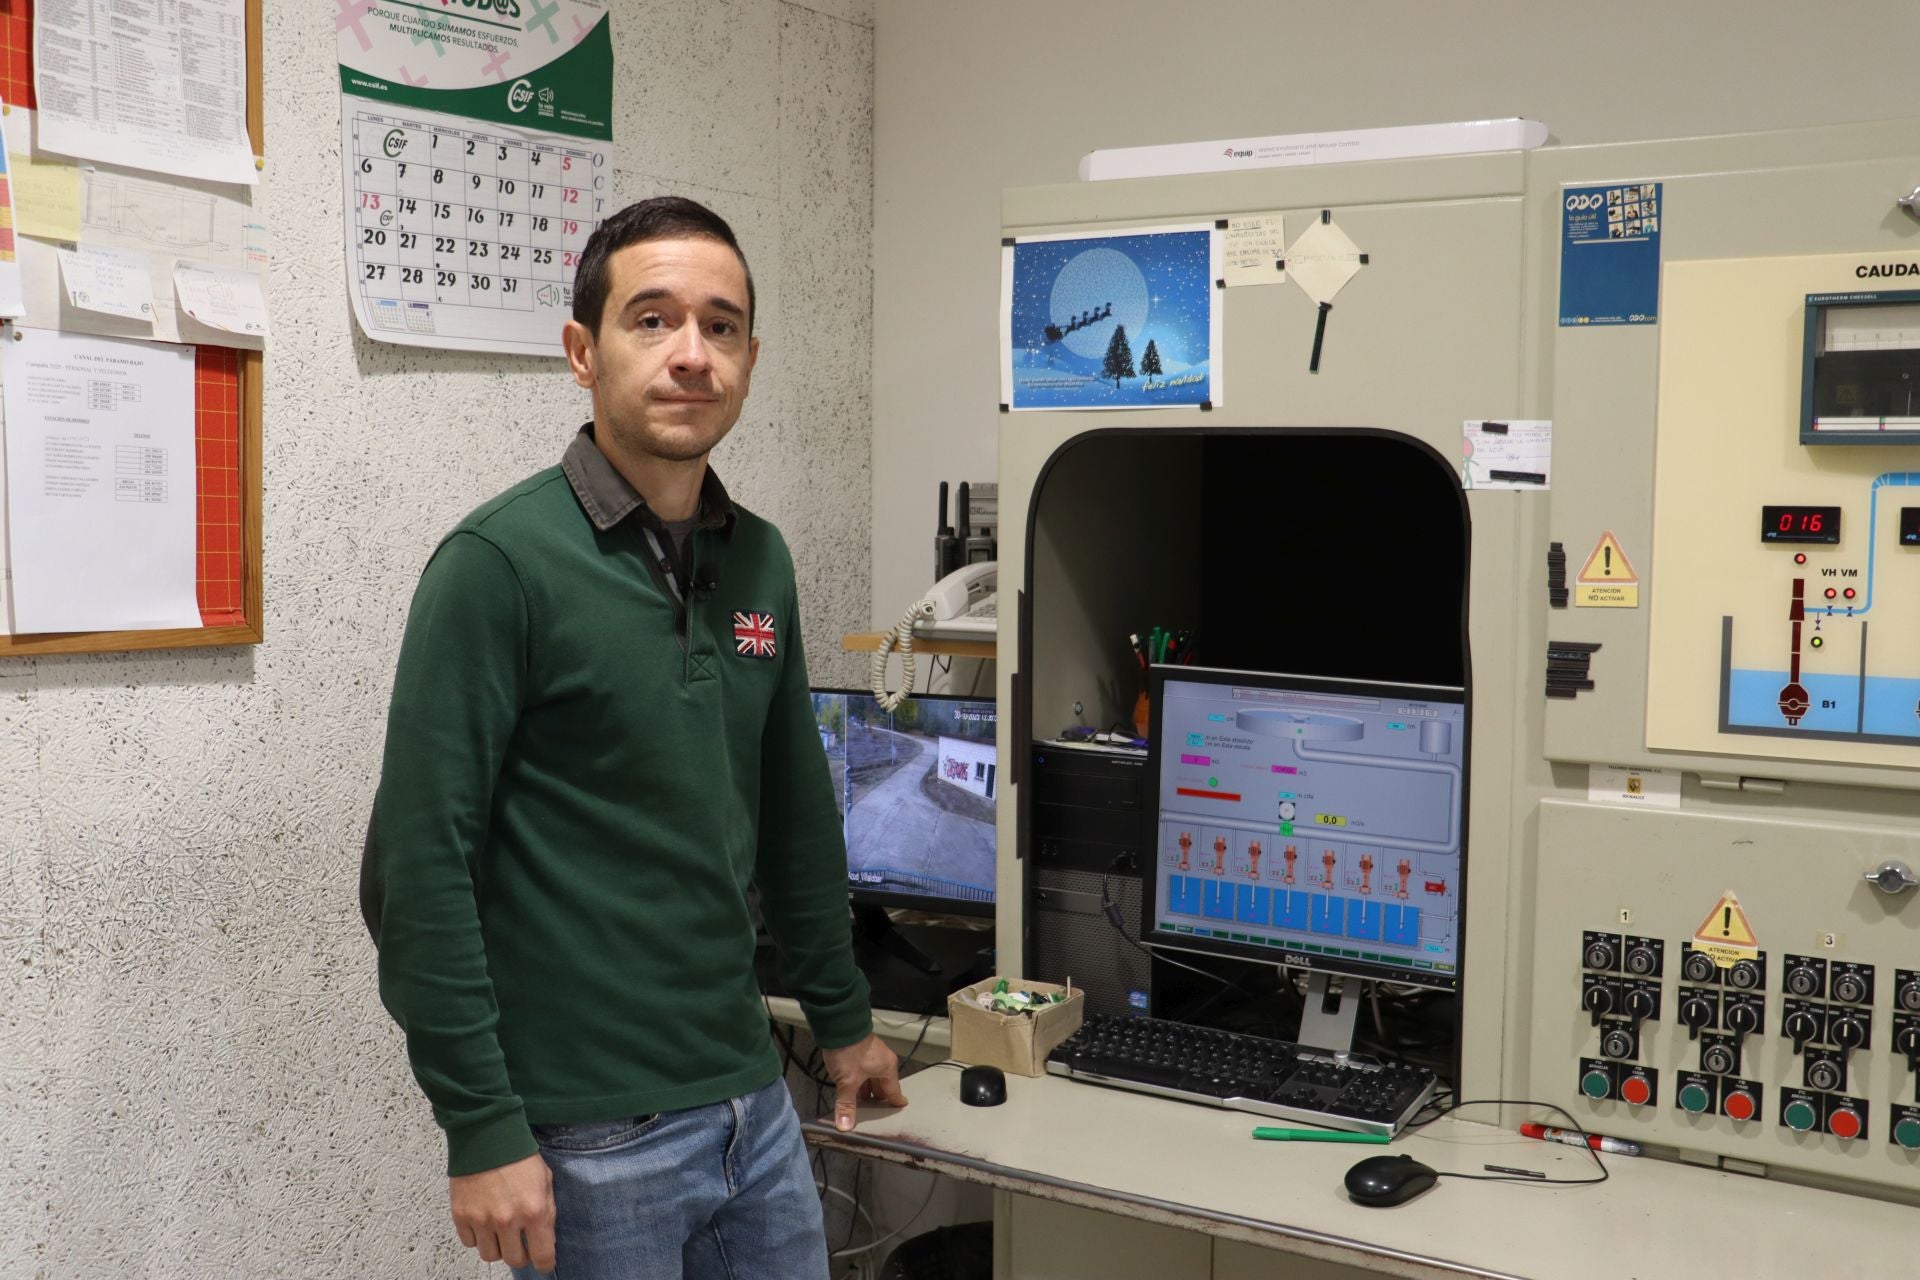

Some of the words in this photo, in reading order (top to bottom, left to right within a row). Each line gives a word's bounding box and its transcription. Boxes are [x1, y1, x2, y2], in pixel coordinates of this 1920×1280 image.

[367, 7, 400, 21] PORQUE
[402, 13, 436, 28] CUANDO
[437, 21, 476, 38] SUMAMOS
[477, 31, 519, 47] ESFUERZOS,
[389, 23, 451, 43] MULTIPLICAMOS
[452, 36, 499, 53] RESULTADOS.
[351, 78, 388, 91] www.csif.es
[402, 121, 422, 129] MARTES
[432, 134, 438, 149] 1
[466, 141, 475, 155] 2
[497, 146, 507, 160] 3
[531, 152, 541, 166] 4
[562, 157, 571, 171] 5
[1233, 149, 1253, 158] equip
[361, 158, 372, 173] 6
[397, 163, 406, 178] 7
[433, 168, 444, 184] 8
[472, 175, 481, 189] 9
[498, 179, 515, 194] 10
[531, 184, 544, 199] 11
[562, 188, 578, 204] 12
[1566, 193, 1604, 212] QDQ
[361, 193, 380, 210] 13
[398, 199, 417, 214] 14
[433, 203, 451, 219] 15
[467, 208, 484, 223] 16
[499, 212, 514, 227] 17
[532, 217, 548, 232] 18
[562, 220, 578, 235] 19
[363, 229, 386, 246] 20
[400, 234, 417, 249] 21
[435, 238, 455, 254] 22
[468, 242, 489, 257] 23
[500, 245, 521, 260] 24
[533, 249, 552, 264] 25
[366, 264, 386, 280] 27
[402, 268, 423, 284] 28
[437, 272, 456, 287] 29
[471, 275, 490, 291] 30
[502, 278, 517, 293] 31
[1142, 379, 1166, 393] feliz
[1169, 373, 1204, 387] navidad
[1779, 513, 1824, 532] 016
[1821, 568, 1837, 577] VH
[1840, 568, 1858, 578] VM
[1821, 700, 1836, 709] B1
[1622, 911, 1628, 921] 1
[1826, 935, 1833, 946] 3
[1285, 954, 1311, 966] DELL
[1708, 947, 1740, 956] ATENCION
